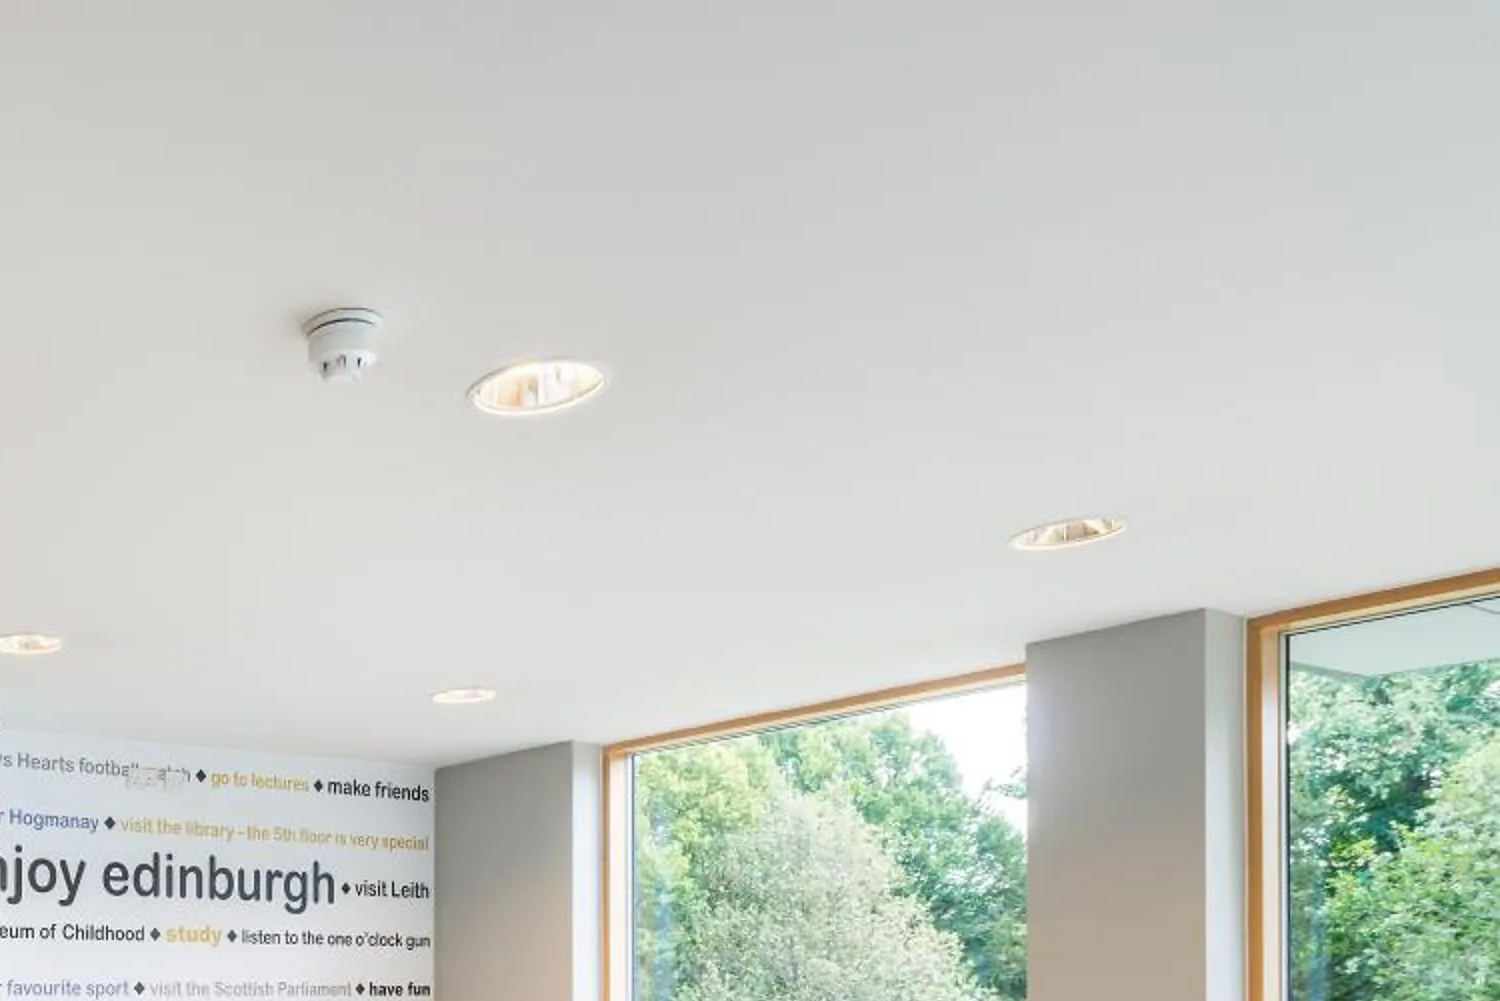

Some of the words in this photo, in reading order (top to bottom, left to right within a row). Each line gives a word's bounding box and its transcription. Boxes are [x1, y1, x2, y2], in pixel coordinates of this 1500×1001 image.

[17, 752, 75, 773] Hearts
[211, 771, 230, 789] go
[233, 771, 249, 787] to
[251, 773, 309, 793] lectures
[327, 779, 372, 798] make
[375, 781, 430, 803] friends
[9, 808, 99, 834] Hogmanay
[121, 817, 151, 833] visit
[156, 819, 181, 836] the
[184, 820, 234, 842] library
[247, 824, 270, 840] the
[273, 827, 297, 843] 5th
[299, 827, 334, 845] floor
[336, 830, 347, 845] is
[349, 833, 379, 852] very
[382, 836, 429, 854] special
[102, 851, 336, 914] edinburgh
[355, 879, 387, 898] visit
[391, 880, 430, 900] Leith
[39, 924, 57, 940] of
[62, 923, 145, 943] Childhood
[166, 925, 222, 949] study
[241, 929, 281, 946] listen
[285, 930, 299, 945] to
[301, 930, 324, 947] the
[327, 934, 352, 948] one
[406, 935, 431, 951] gun
[7, 979, 83, 998] favourite
[86, 980, 130, 1001] sport
[150, 981, 181, 997] visit
[184, 981, 209, 997] the
[213, 981, 274, 998] Scottish
[277, 981, 352, 998] Parliament
[369, 982, 403, 997] have
[407, 982, 431, 997] fun
